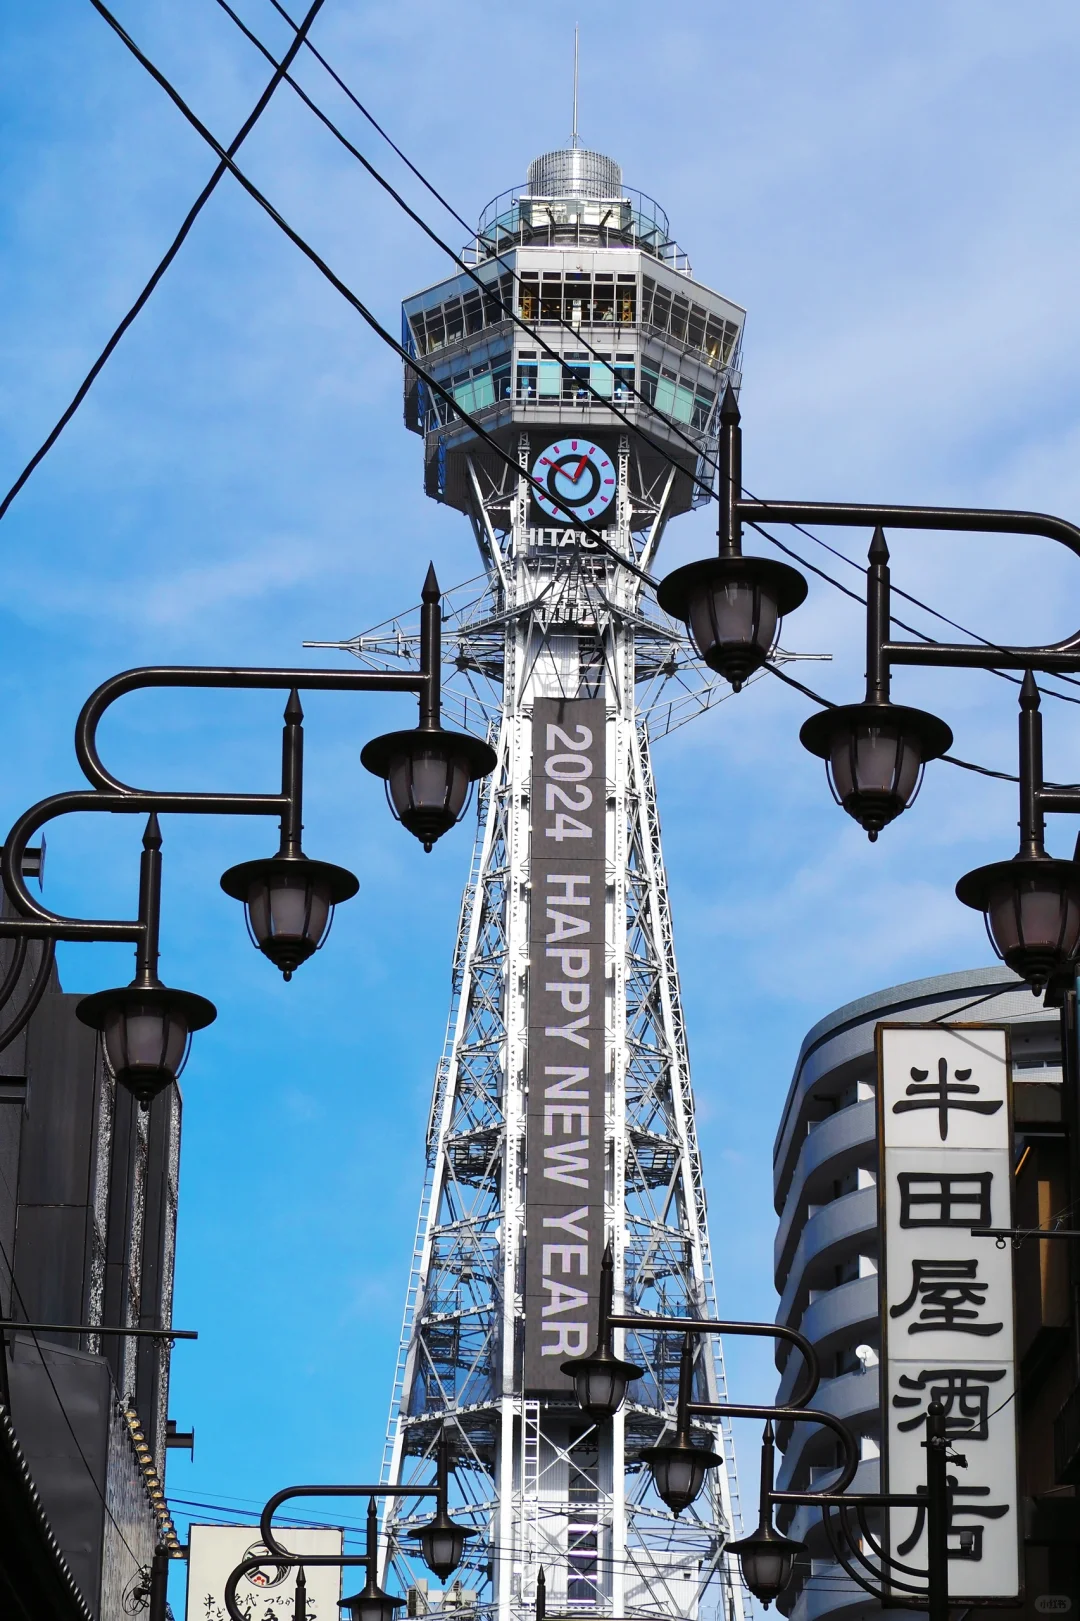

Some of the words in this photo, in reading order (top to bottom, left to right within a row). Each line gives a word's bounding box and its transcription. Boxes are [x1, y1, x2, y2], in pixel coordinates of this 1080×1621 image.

[516, 528, 629, 548] HITACHI
[544, 723, 593, 842] 2024
[544, 874, 591, 1050] HAPPY
[543, 1066, 590, 1189] NEW
[541, 1205, 589, 1357] YEAR
[889, 1057, 1010, 1562] 半田屋酒店
